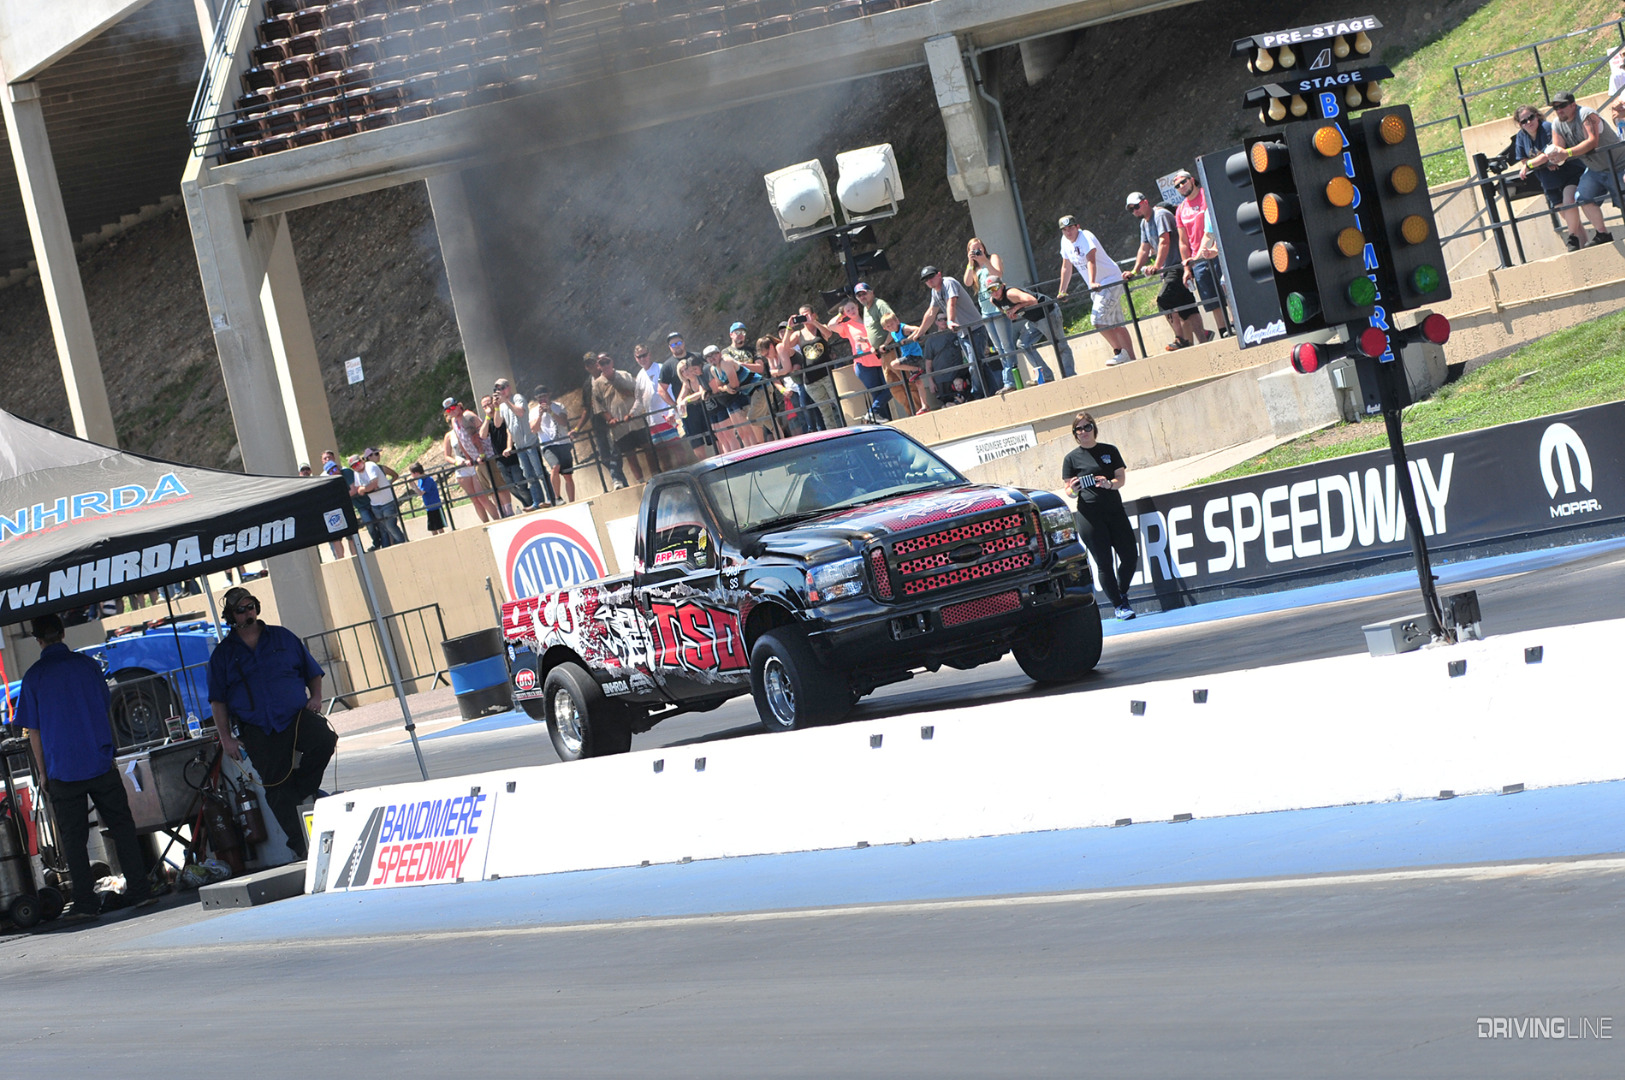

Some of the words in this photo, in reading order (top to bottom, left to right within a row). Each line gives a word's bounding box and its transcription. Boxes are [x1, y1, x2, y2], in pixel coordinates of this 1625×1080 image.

[1263, 18, 1375, 47] PRE-STAGE
[1300, 71, 1362, 91] STAGE
[1002, 433, 1028, 448] SPEEDWAY
[0, 472, 190, 541] NHRDA
[1203, 452, 1455, 573] SPEEDWAY
[379, 794, 487, 844] BANDIMERE
[372, 838, 473, 885] SPEEDWAY
